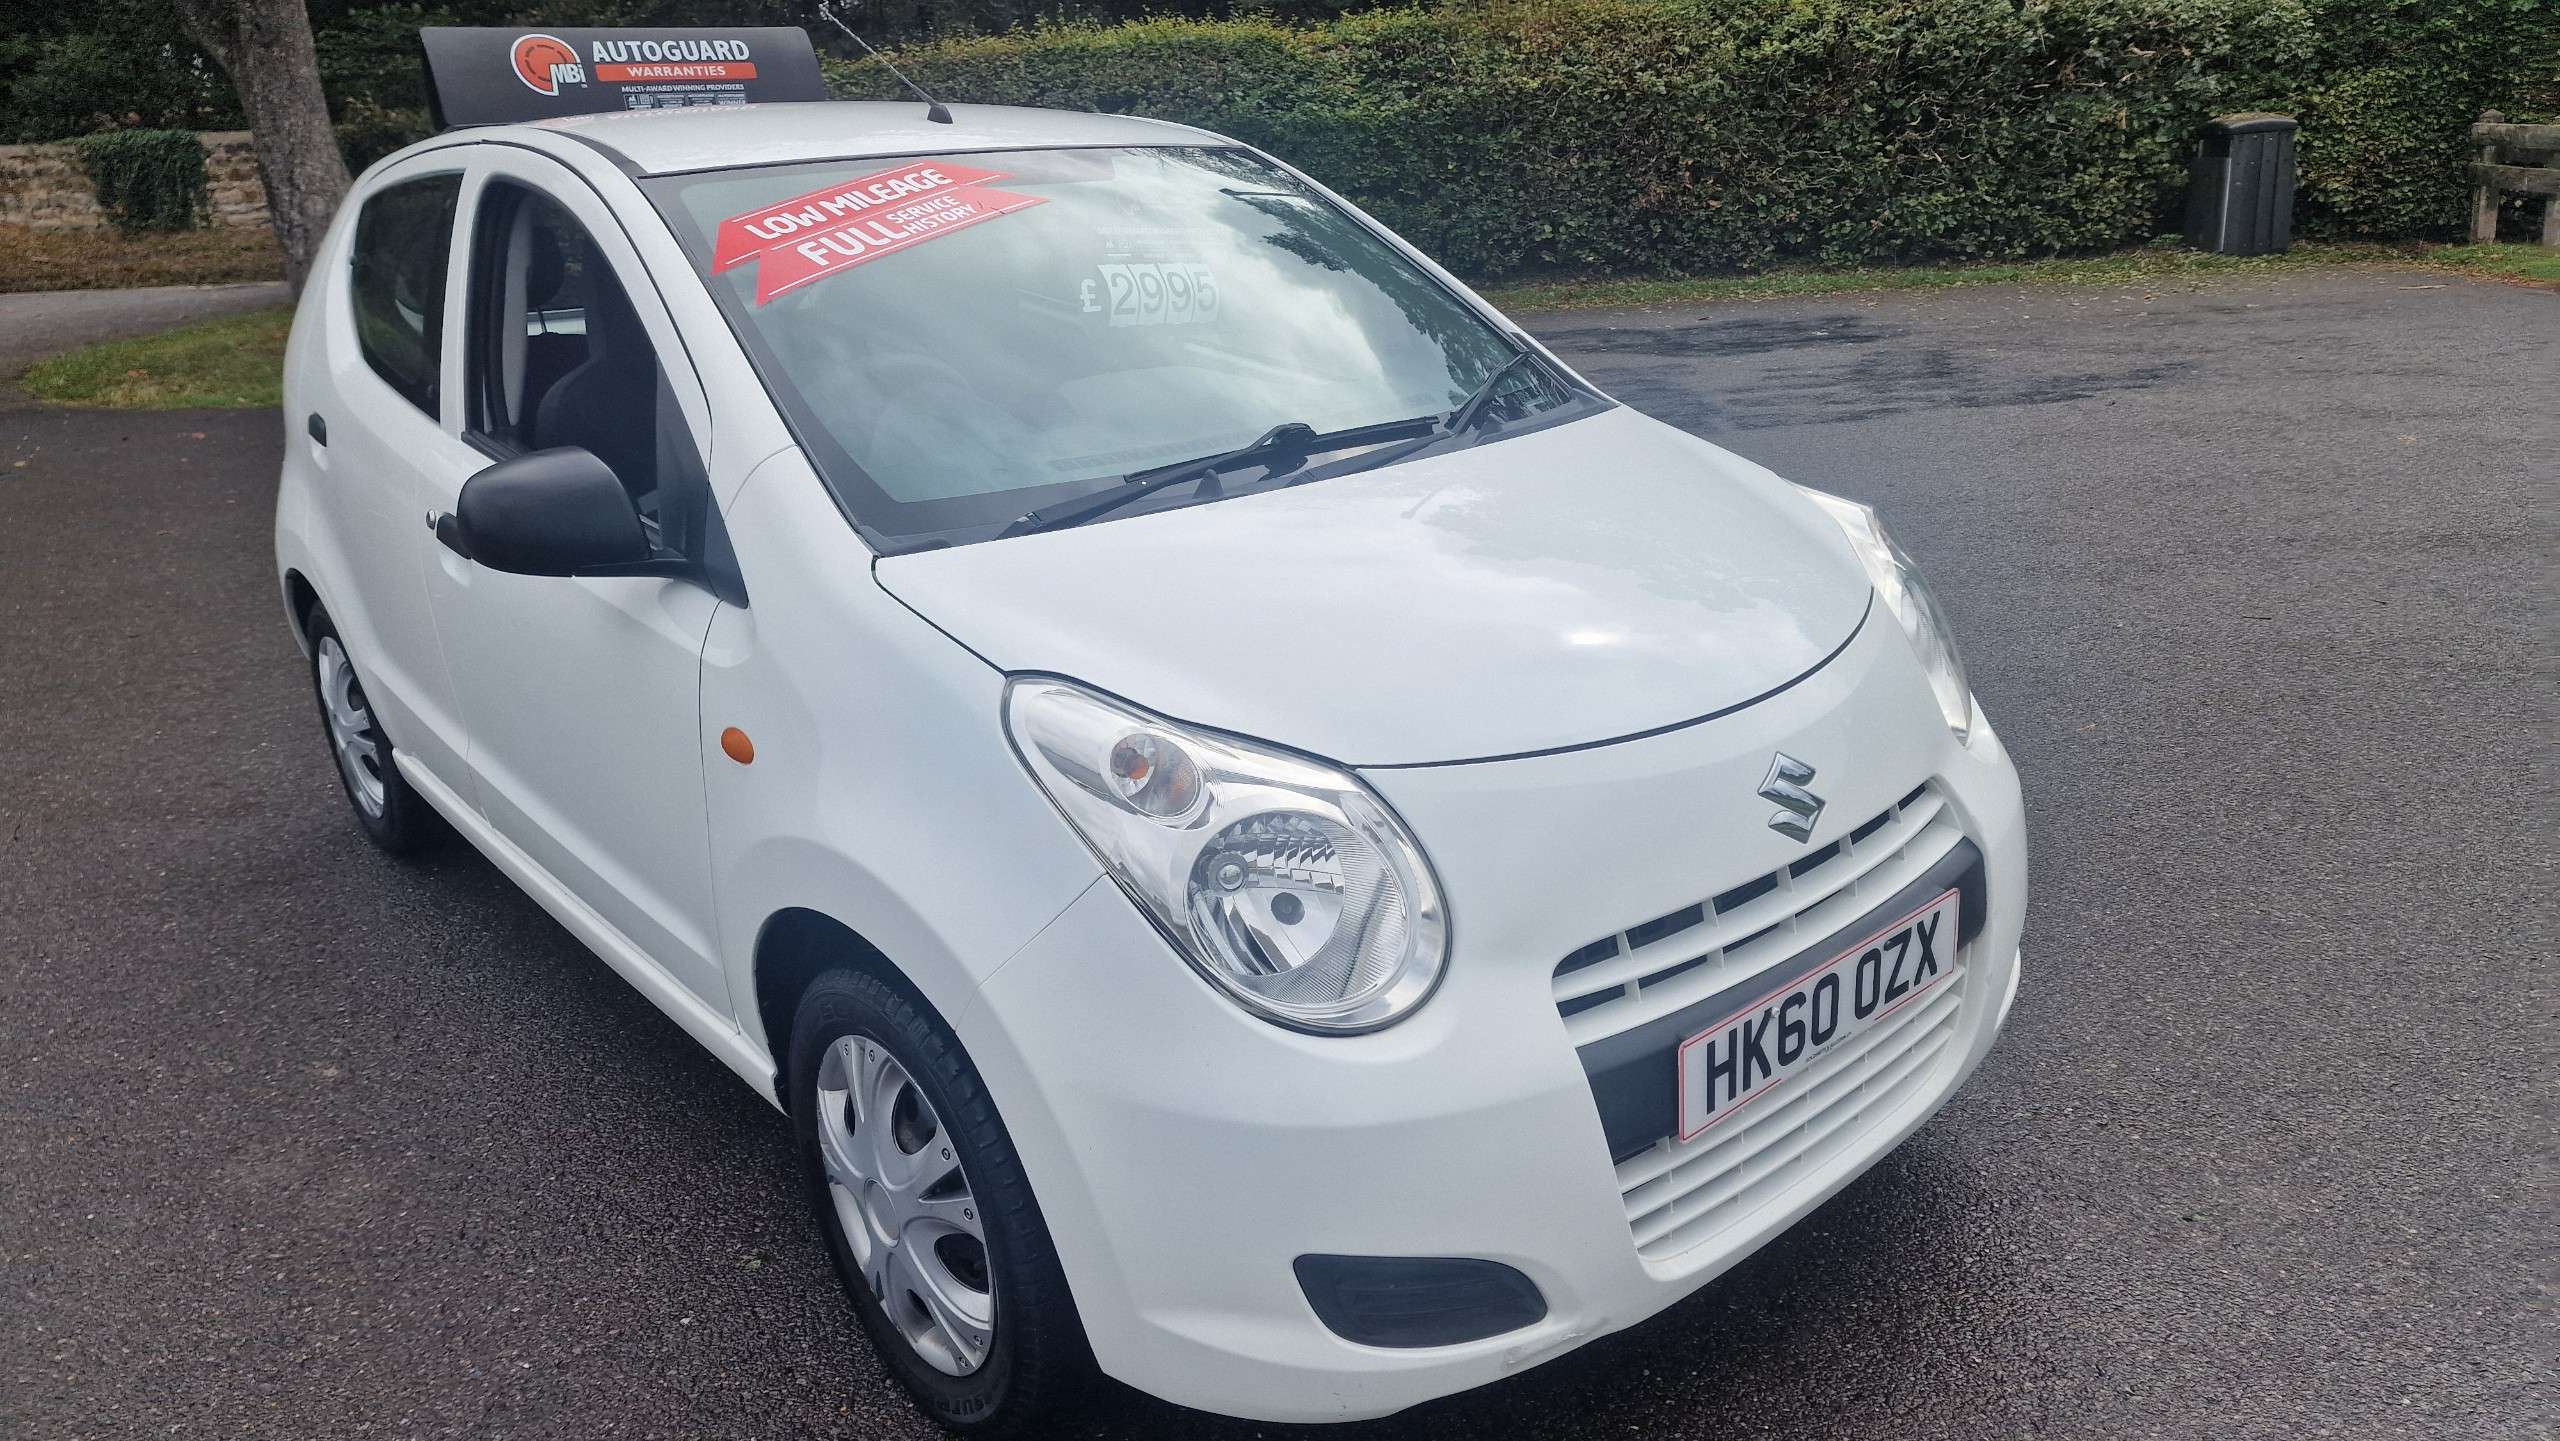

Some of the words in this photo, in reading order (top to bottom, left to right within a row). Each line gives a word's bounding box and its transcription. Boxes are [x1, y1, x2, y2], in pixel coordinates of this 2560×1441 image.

[592, 40, 750, 62] AUTOGUARD
[627, 65, 726, 77] WARRANTIES
[621, 84, 673, 93] MULTI-AWARD
[706, 83, 745, 91] PROVIDERS
[744, 204, 828, 240] LOW
[820, 168, 954, 217] MILEAGE
[886, 196, 961, 224] SERVICE
[902, 203, 974, 235] HISTORY
[796, 220, 908, 266] FULL
[1706, 972, 1840, 1116] HK60
[1854, 910, 1941, 1020] OZX
